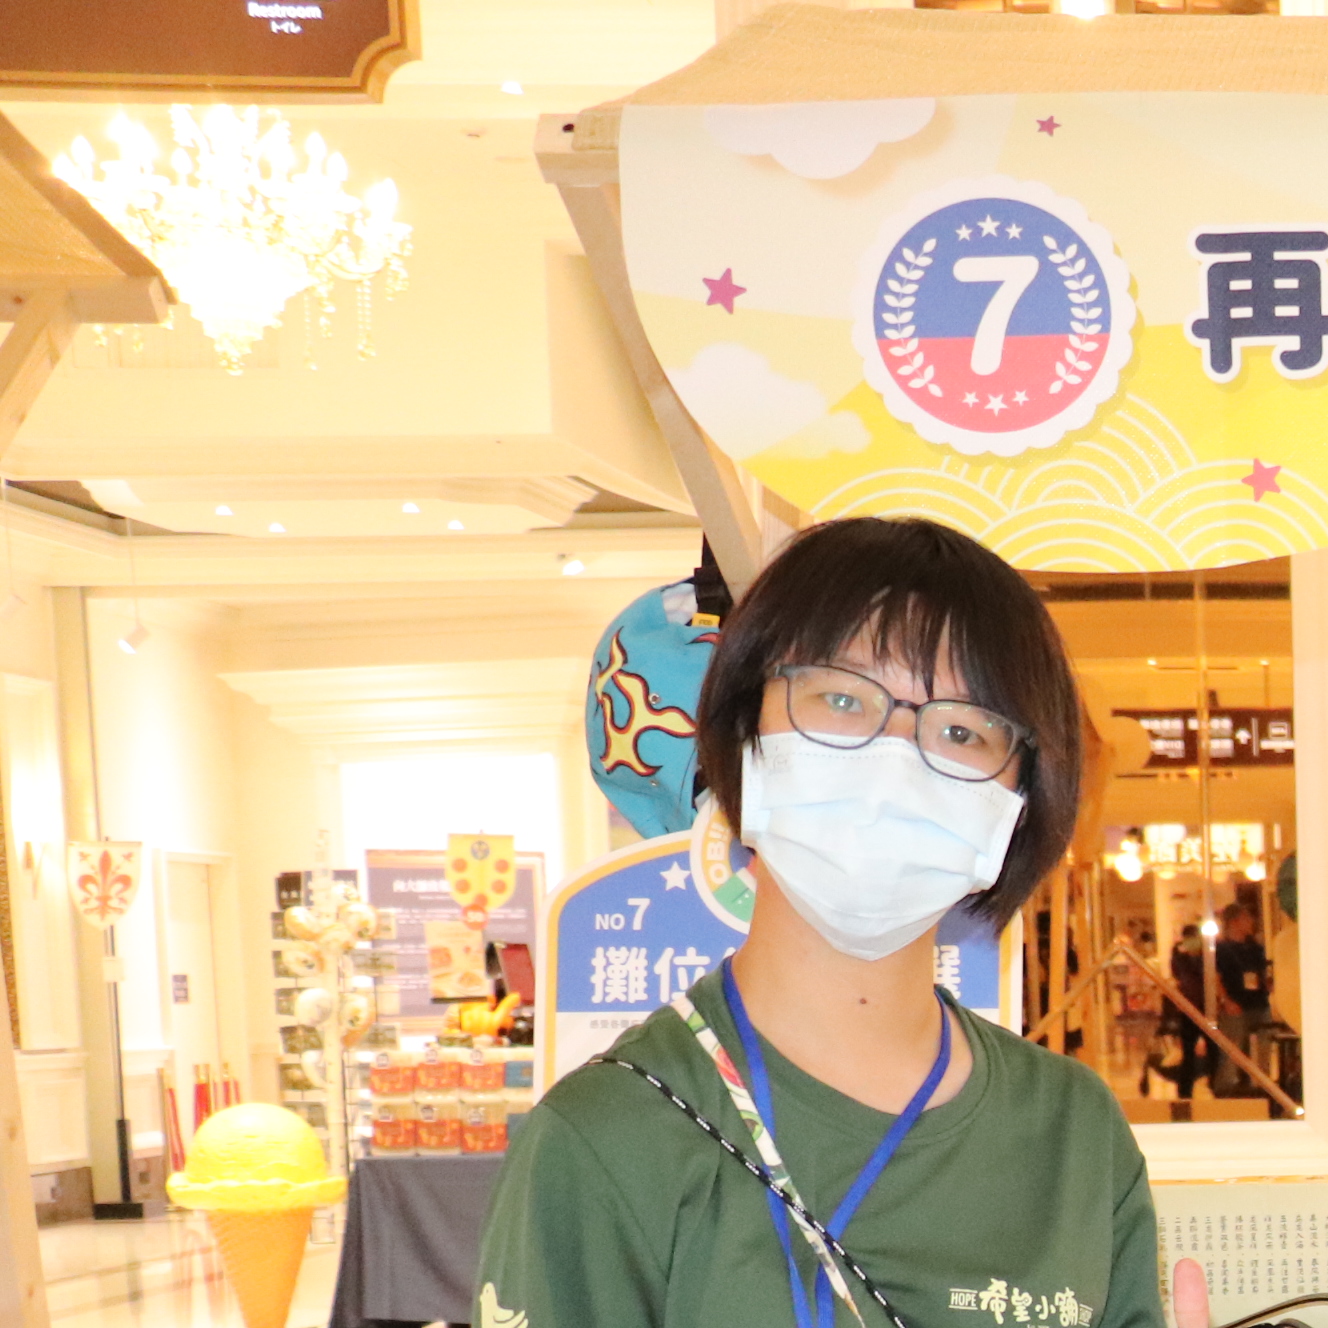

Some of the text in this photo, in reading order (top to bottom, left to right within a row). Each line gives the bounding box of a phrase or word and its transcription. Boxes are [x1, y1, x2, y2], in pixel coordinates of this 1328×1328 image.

[247, 1, 323, 19] Restroom
[952, 255, 1040, 376] 7
[590, 946, 736, 1004] 攤位
[951, 1292, 977, 1307] HOPE
